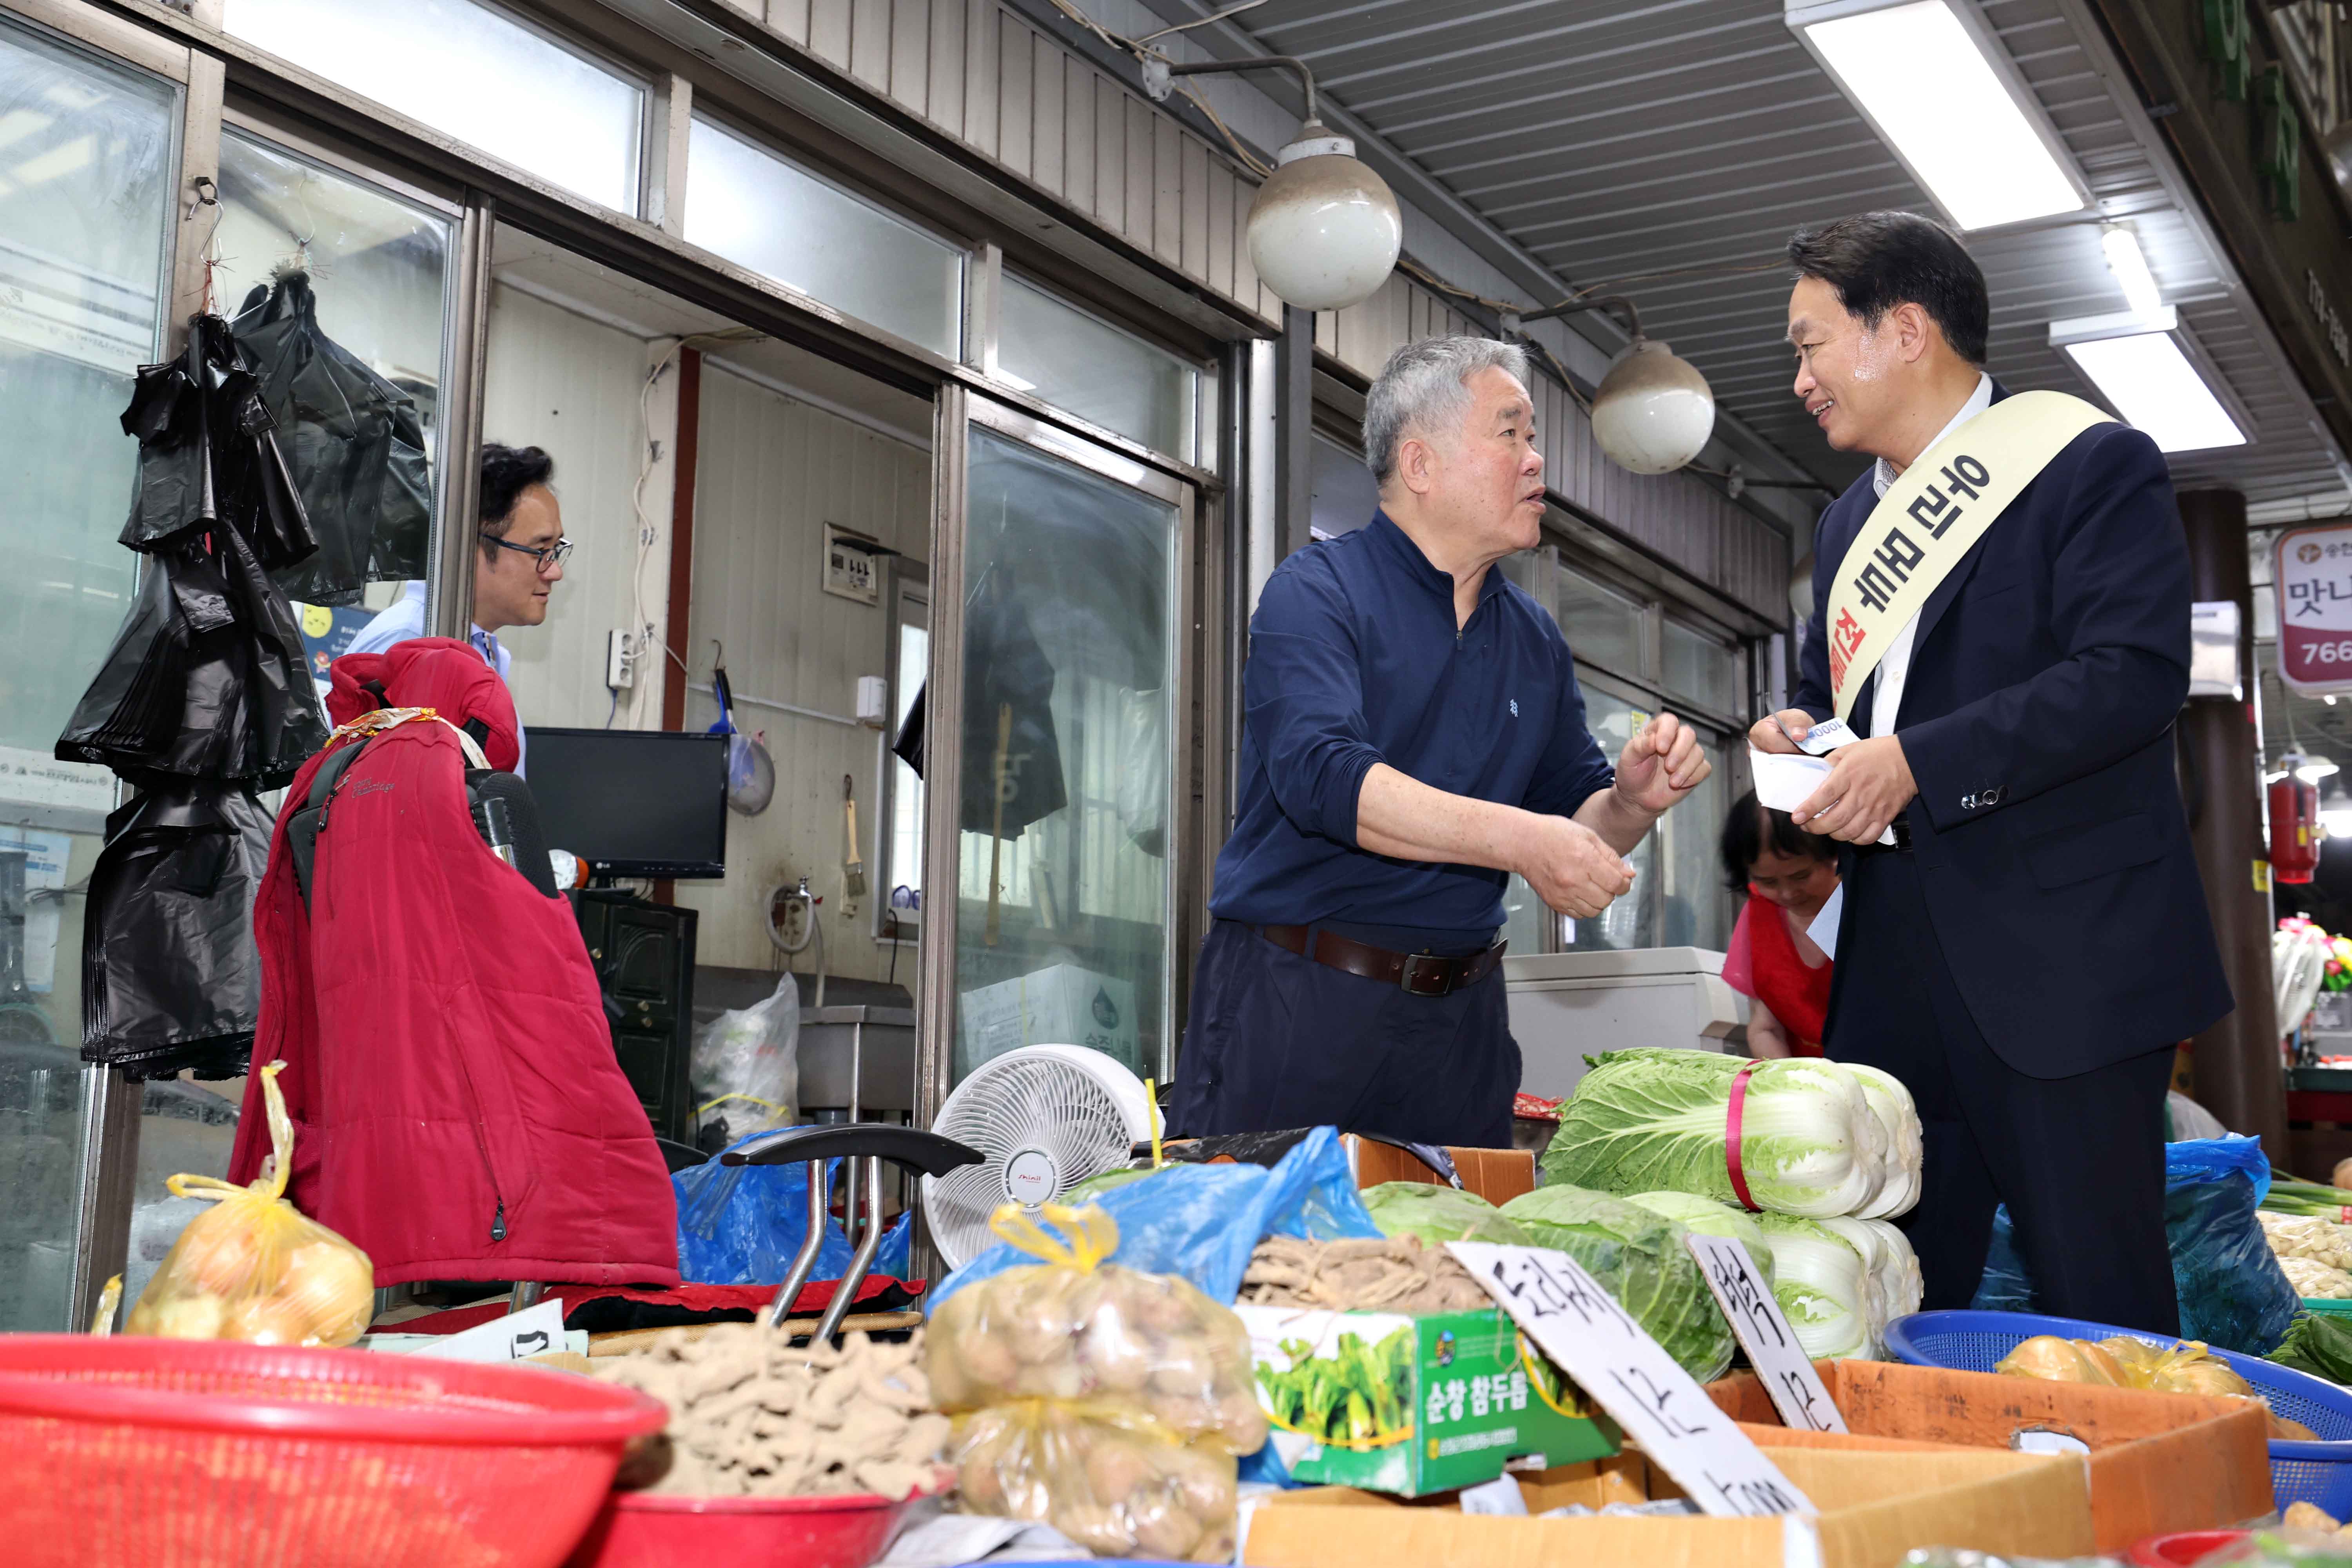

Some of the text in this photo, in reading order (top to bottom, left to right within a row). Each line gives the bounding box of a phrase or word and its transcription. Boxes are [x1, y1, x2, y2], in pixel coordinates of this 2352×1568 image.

[1906, 455, 1990, 540] 우리
[1853, 526, 1925, 614] 모두
[2301, 640, 2352, 665] 766
[1493, 1254, 1636, 1337] 도라지
[1425, 1370, 1529, 1425] 순창 참두릅
